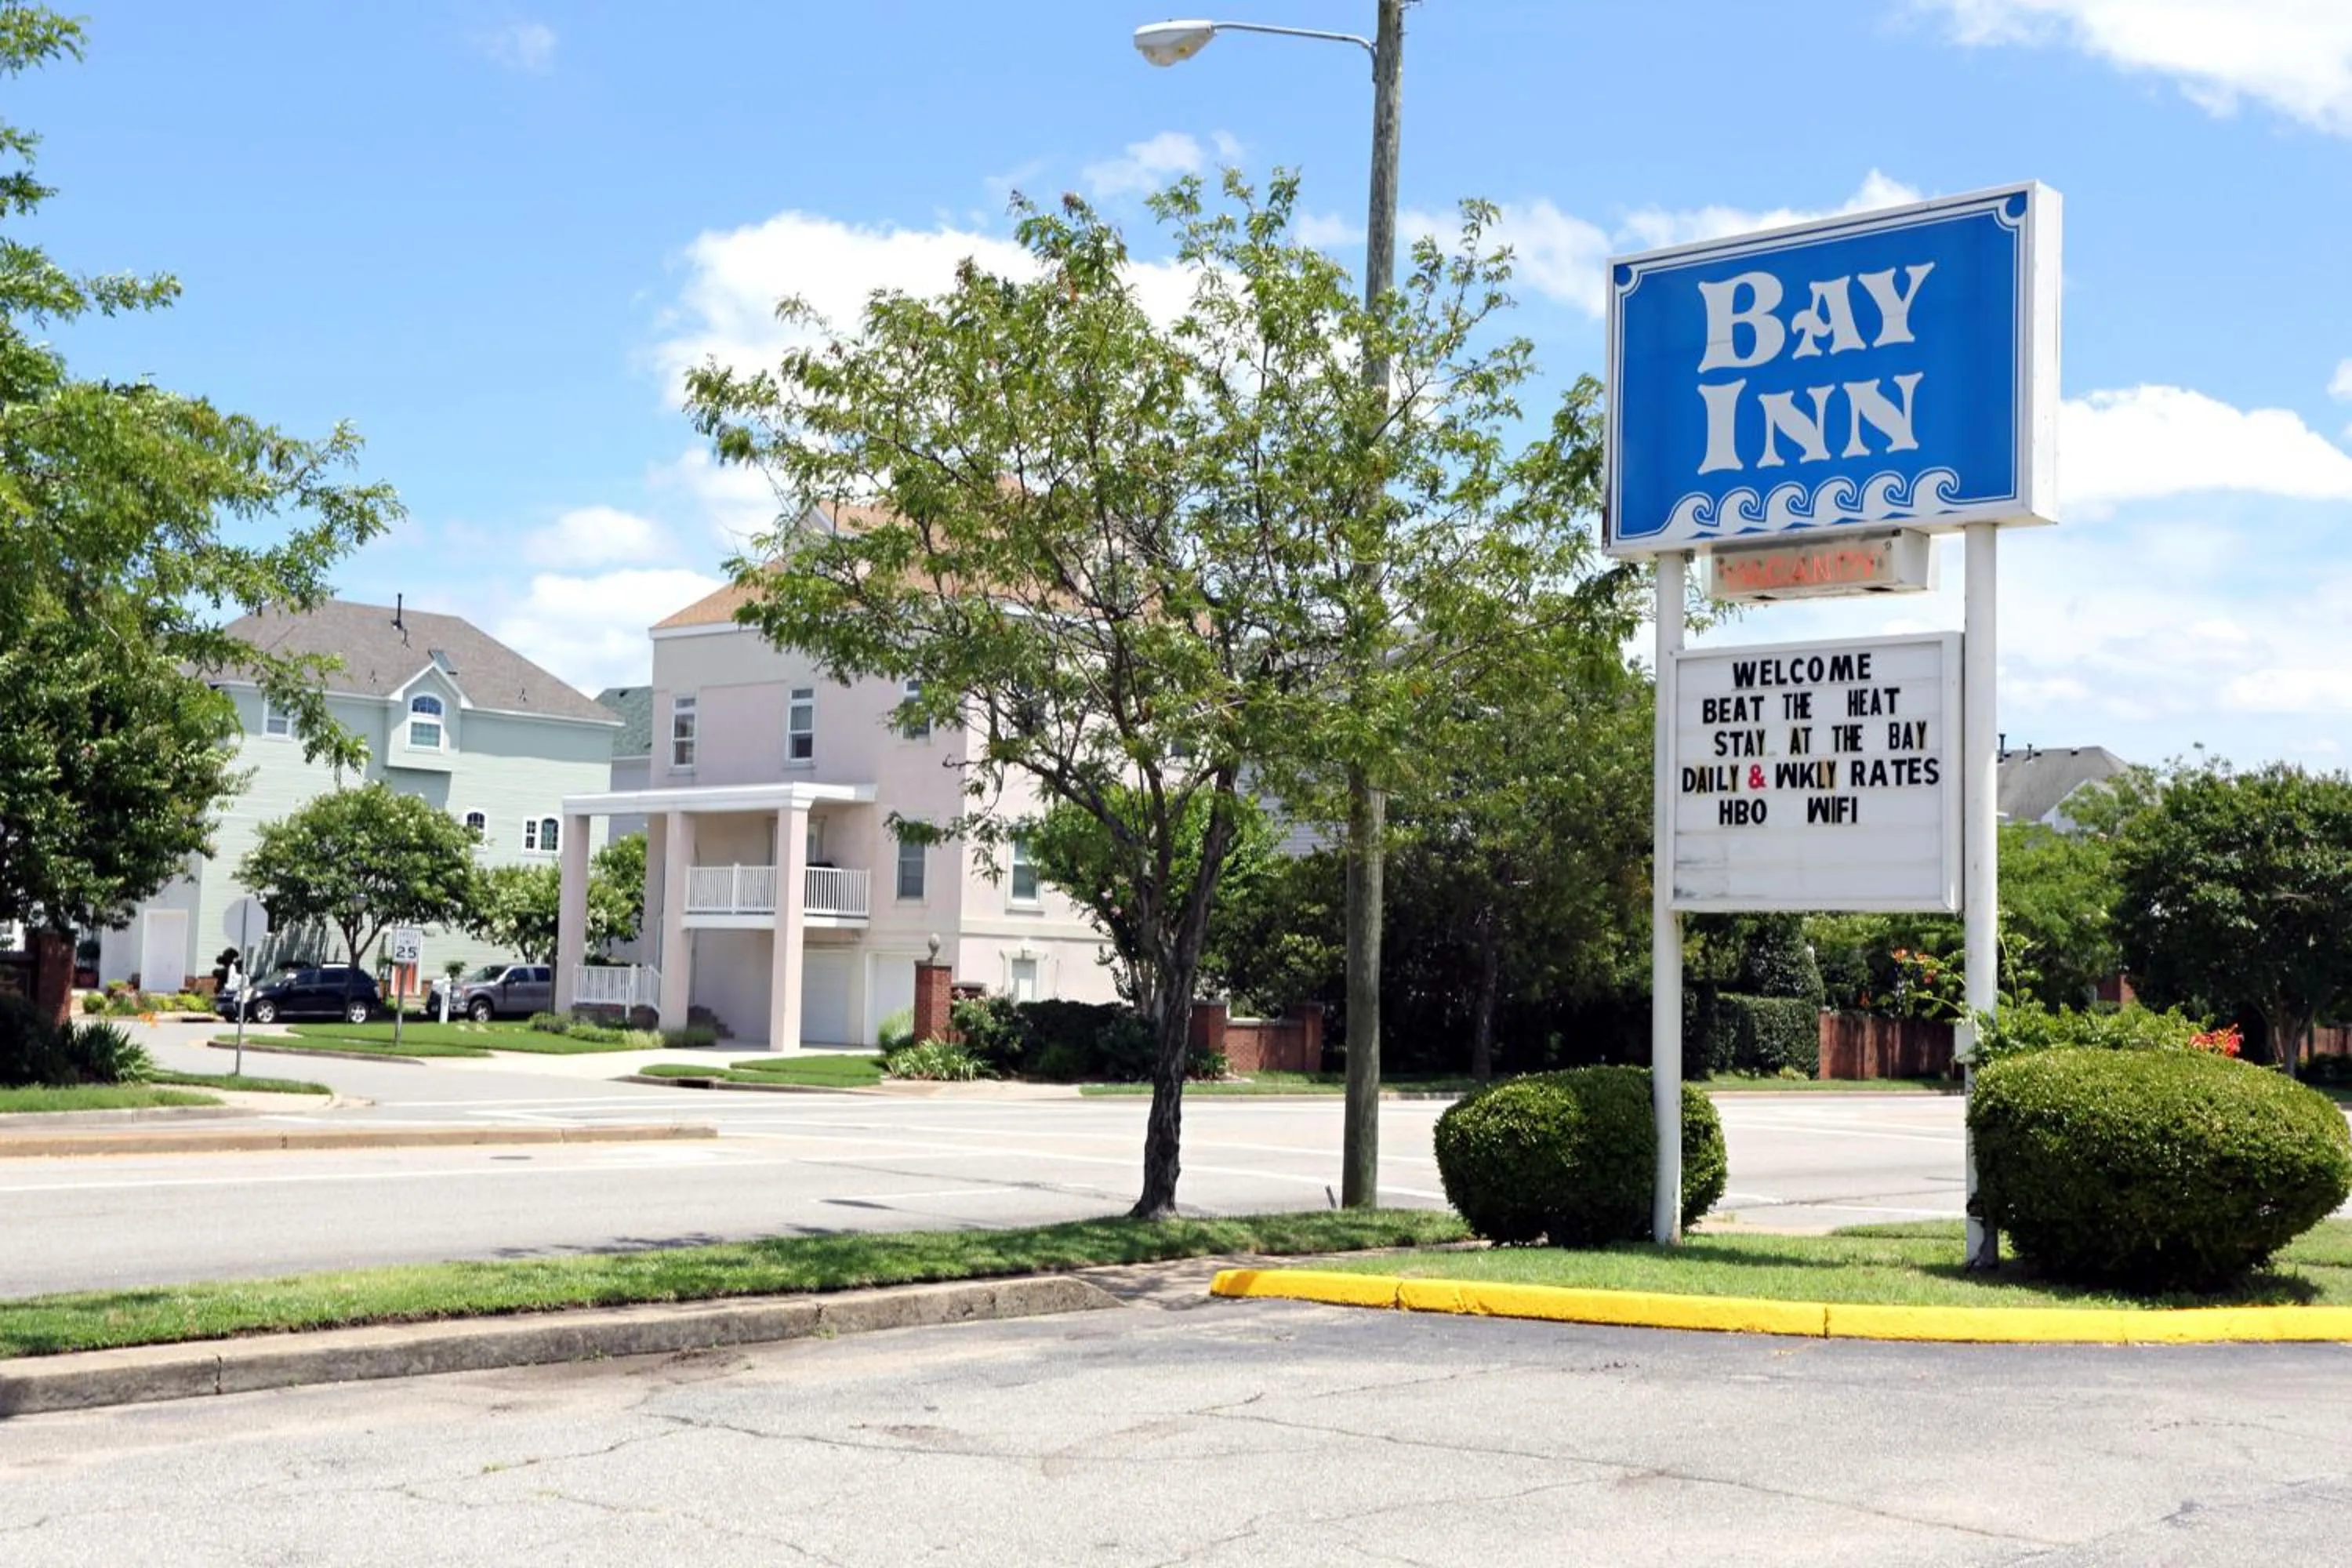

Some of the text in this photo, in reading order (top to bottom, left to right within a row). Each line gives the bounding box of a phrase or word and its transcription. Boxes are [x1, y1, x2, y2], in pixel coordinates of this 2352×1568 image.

[1697, 261, 1935, 374] BAY
[1697, 372, 1924, 476] INN
[1733, 653, 1871, 688] WELCOME
[1703, 688, 1900, 724] BEAT THE HEAT
[1714, 720, 1927, 757] STAY AT THE BAY
[1682, 757, 1940, 793] DAILY & WKLY RATES
[1719, 796, 1857, 825] HBO WIFI
[396, 946, 417, 958] 25
